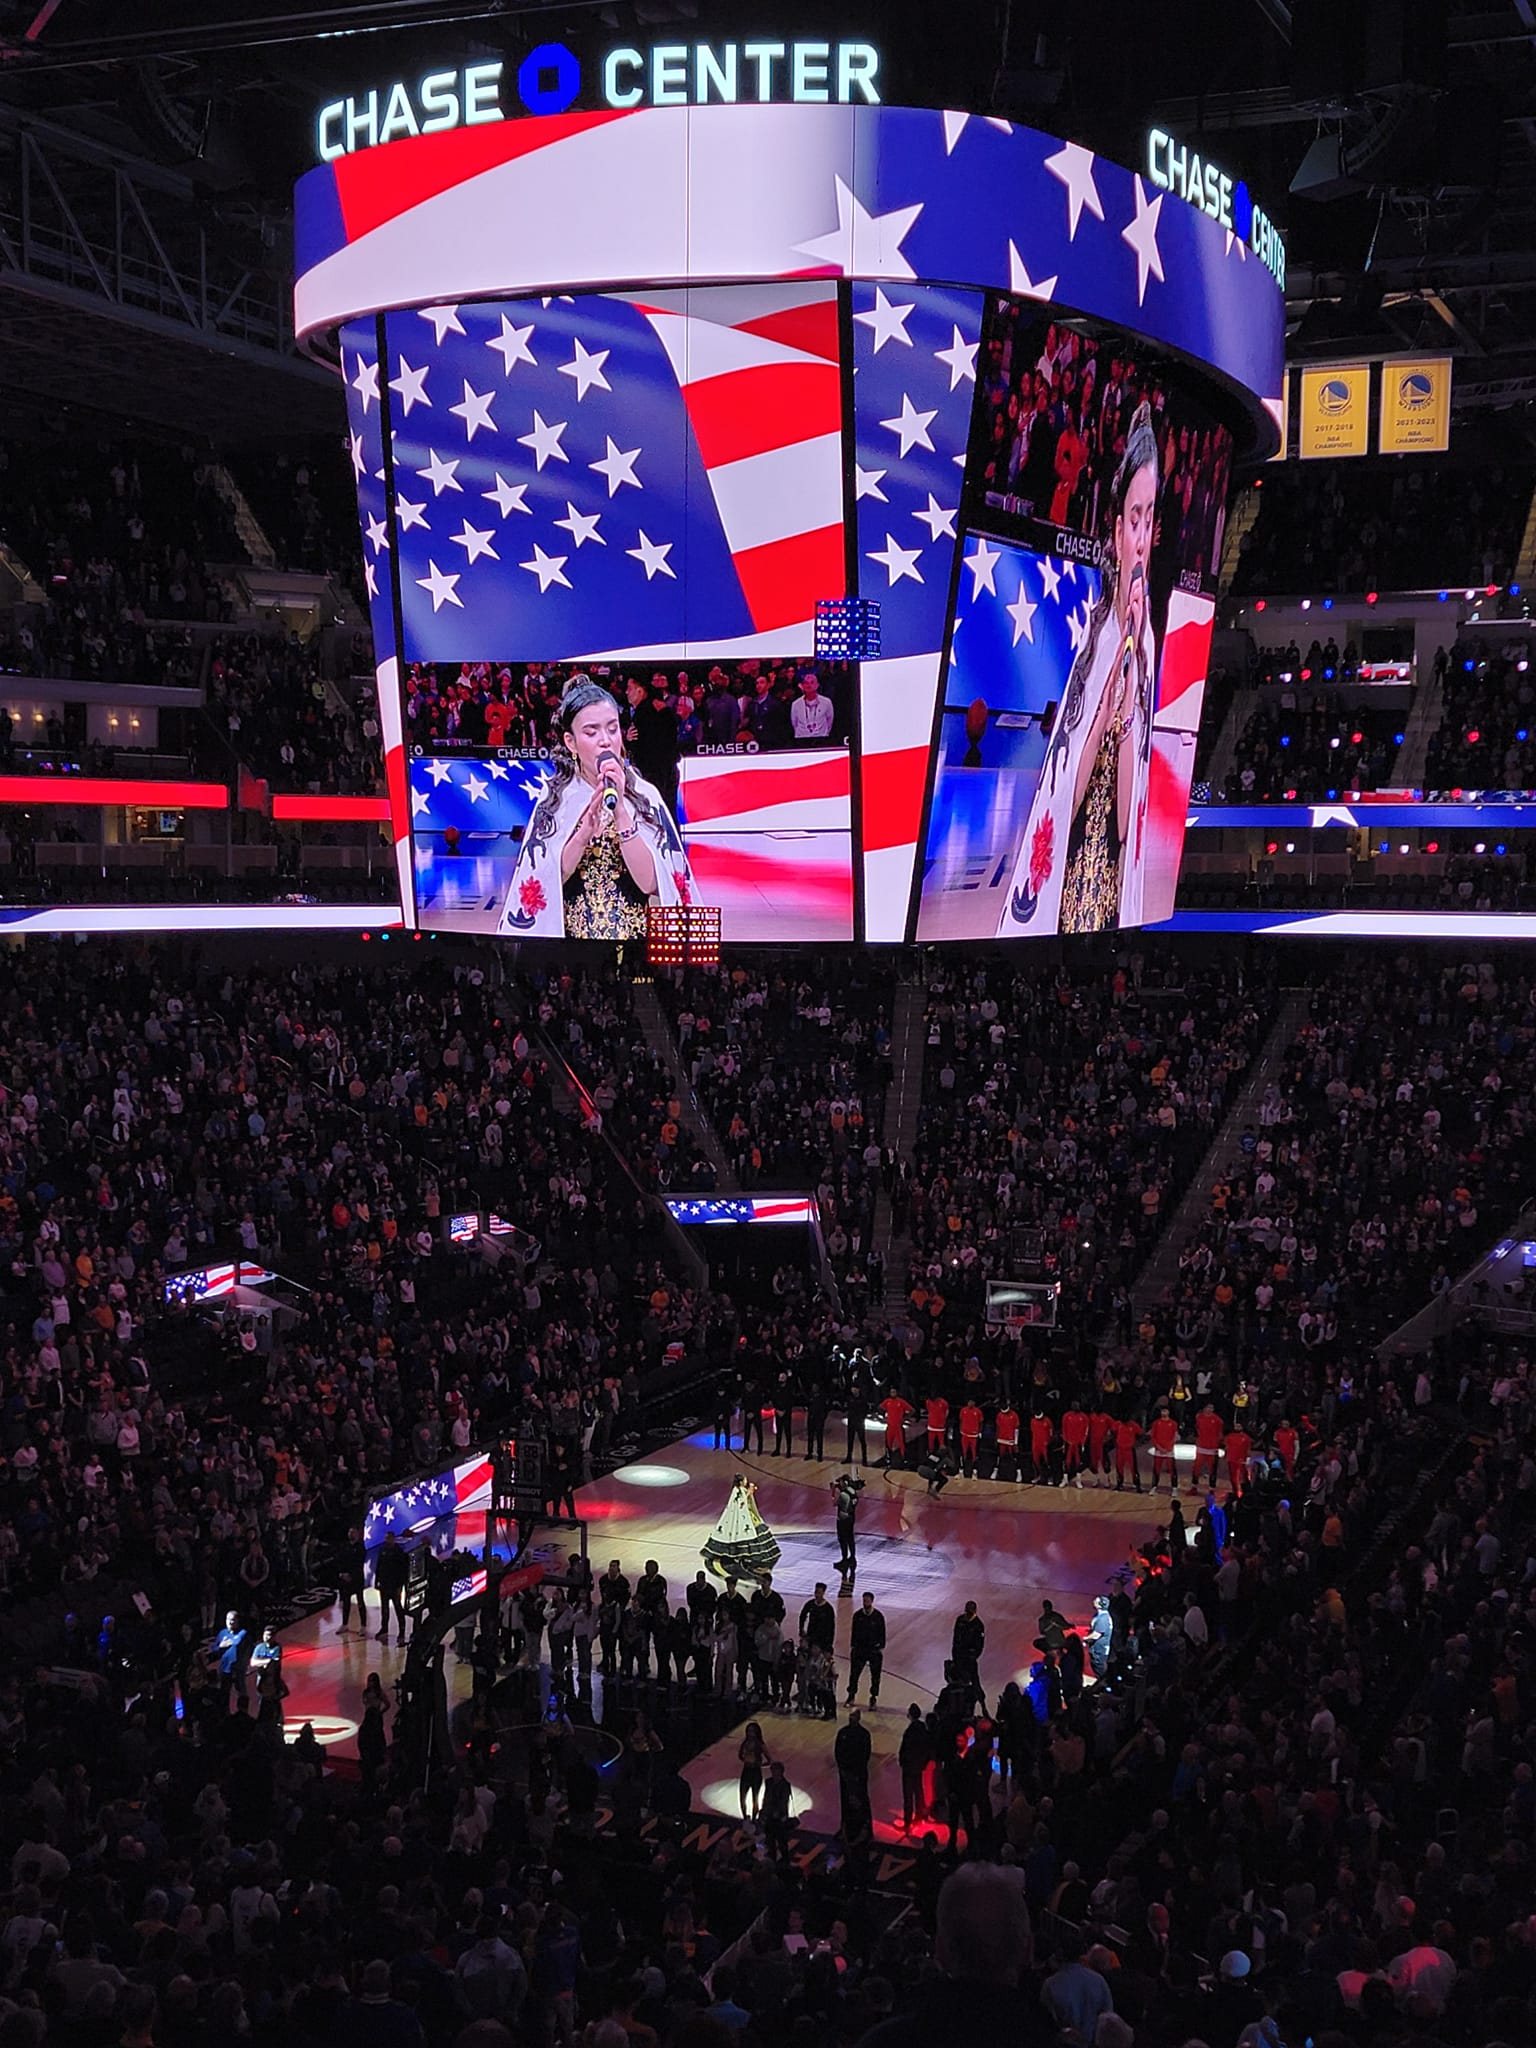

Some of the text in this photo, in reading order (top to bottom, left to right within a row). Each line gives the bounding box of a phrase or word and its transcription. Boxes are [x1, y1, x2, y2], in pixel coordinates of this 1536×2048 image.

[317, 42, 881, 163] CHASE CENTER
[1148, 128, 1286, 292] CHASE CENTER
[1056, 532, 1092, 560] CHASE
[496, 747, 537, 759] CHASE
[696, 742, 745, 755] CHASE
